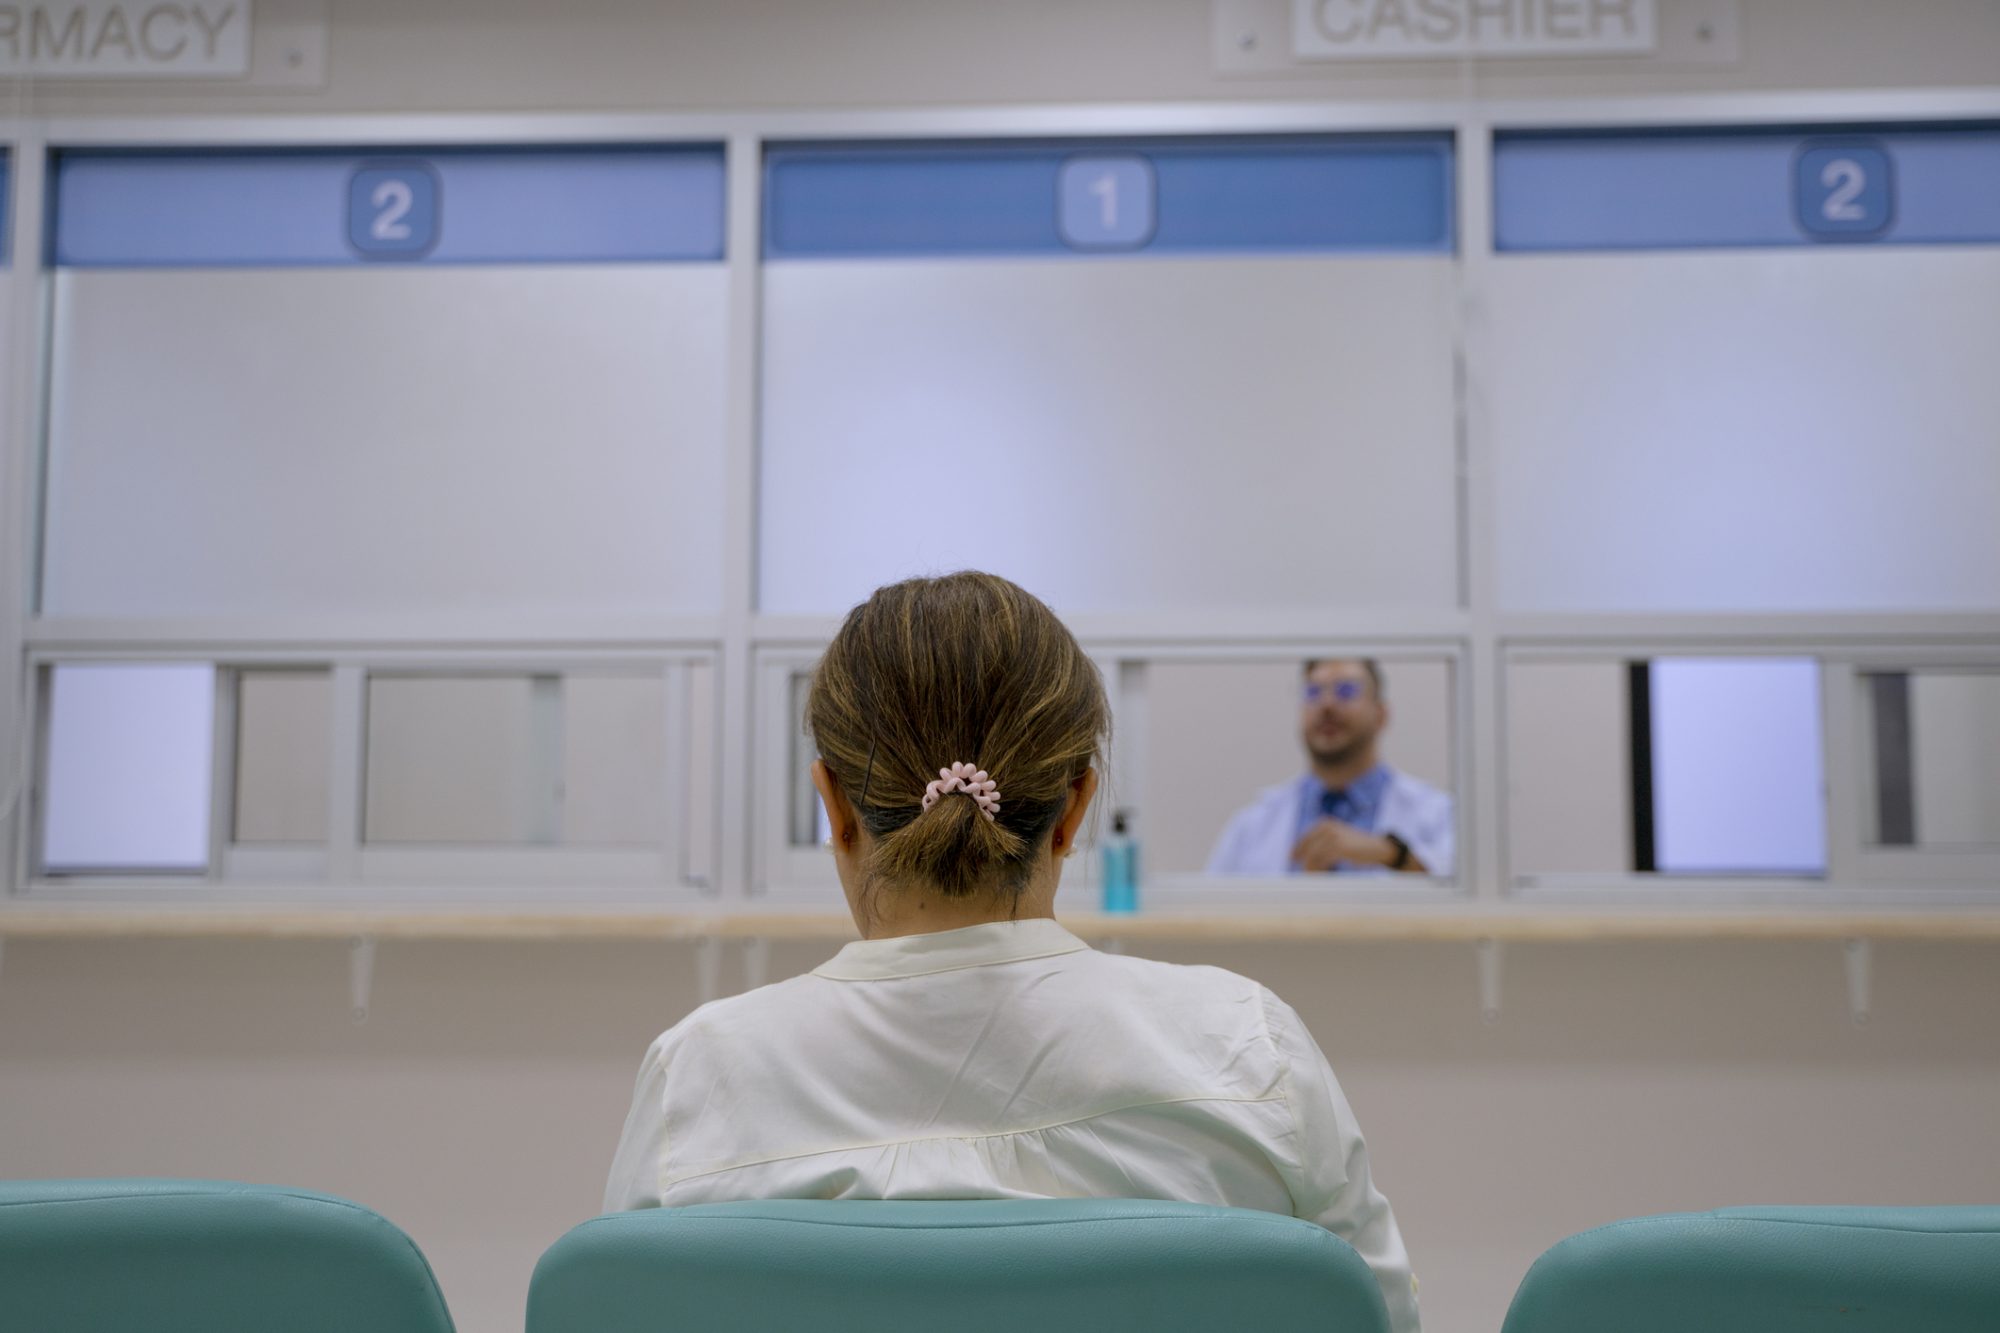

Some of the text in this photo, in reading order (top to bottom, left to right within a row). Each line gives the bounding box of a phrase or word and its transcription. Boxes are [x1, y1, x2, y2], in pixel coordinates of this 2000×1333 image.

[1313, 0, 1637, 43] CASHIER
[371, 180, 413, 240] 2
[1088, 173, 1118, 229] 1
[1821, 159, 1866, 220] 2
